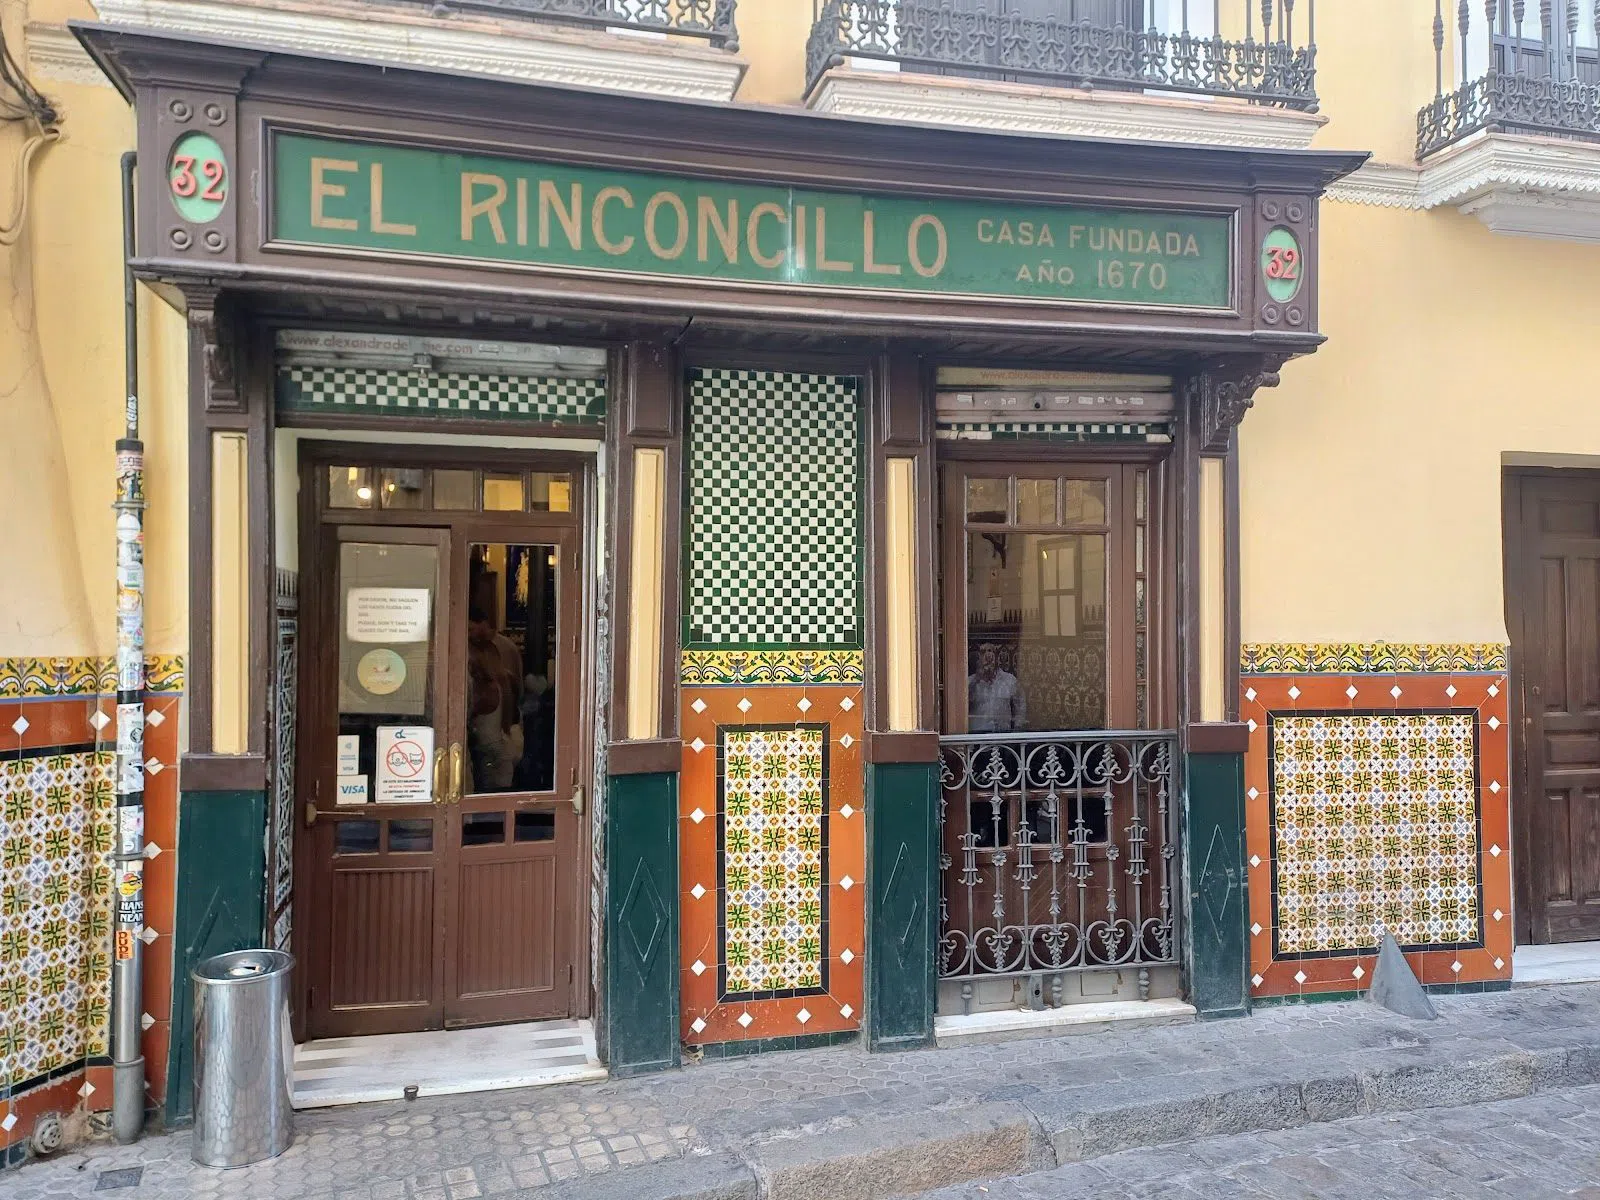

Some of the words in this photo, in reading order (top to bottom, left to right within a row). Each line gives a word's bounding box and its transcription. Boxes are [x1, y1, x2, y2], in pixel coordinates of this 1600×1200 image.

[171, 155, 225, 201] 32
[310, 157, 417, 236] EL
[460, 172, 947, 278] RINCONCILLO
[977, 219, 1054, 248] CASA
[1069, 225, 1200, 257] FUNDADA
[1016, 259, 1075, 286] AÑO
[1097, 260, 1167, 290] 1670
[1265, 247, 1301, 280] 32
[340, 785, 366, 794] VISA
